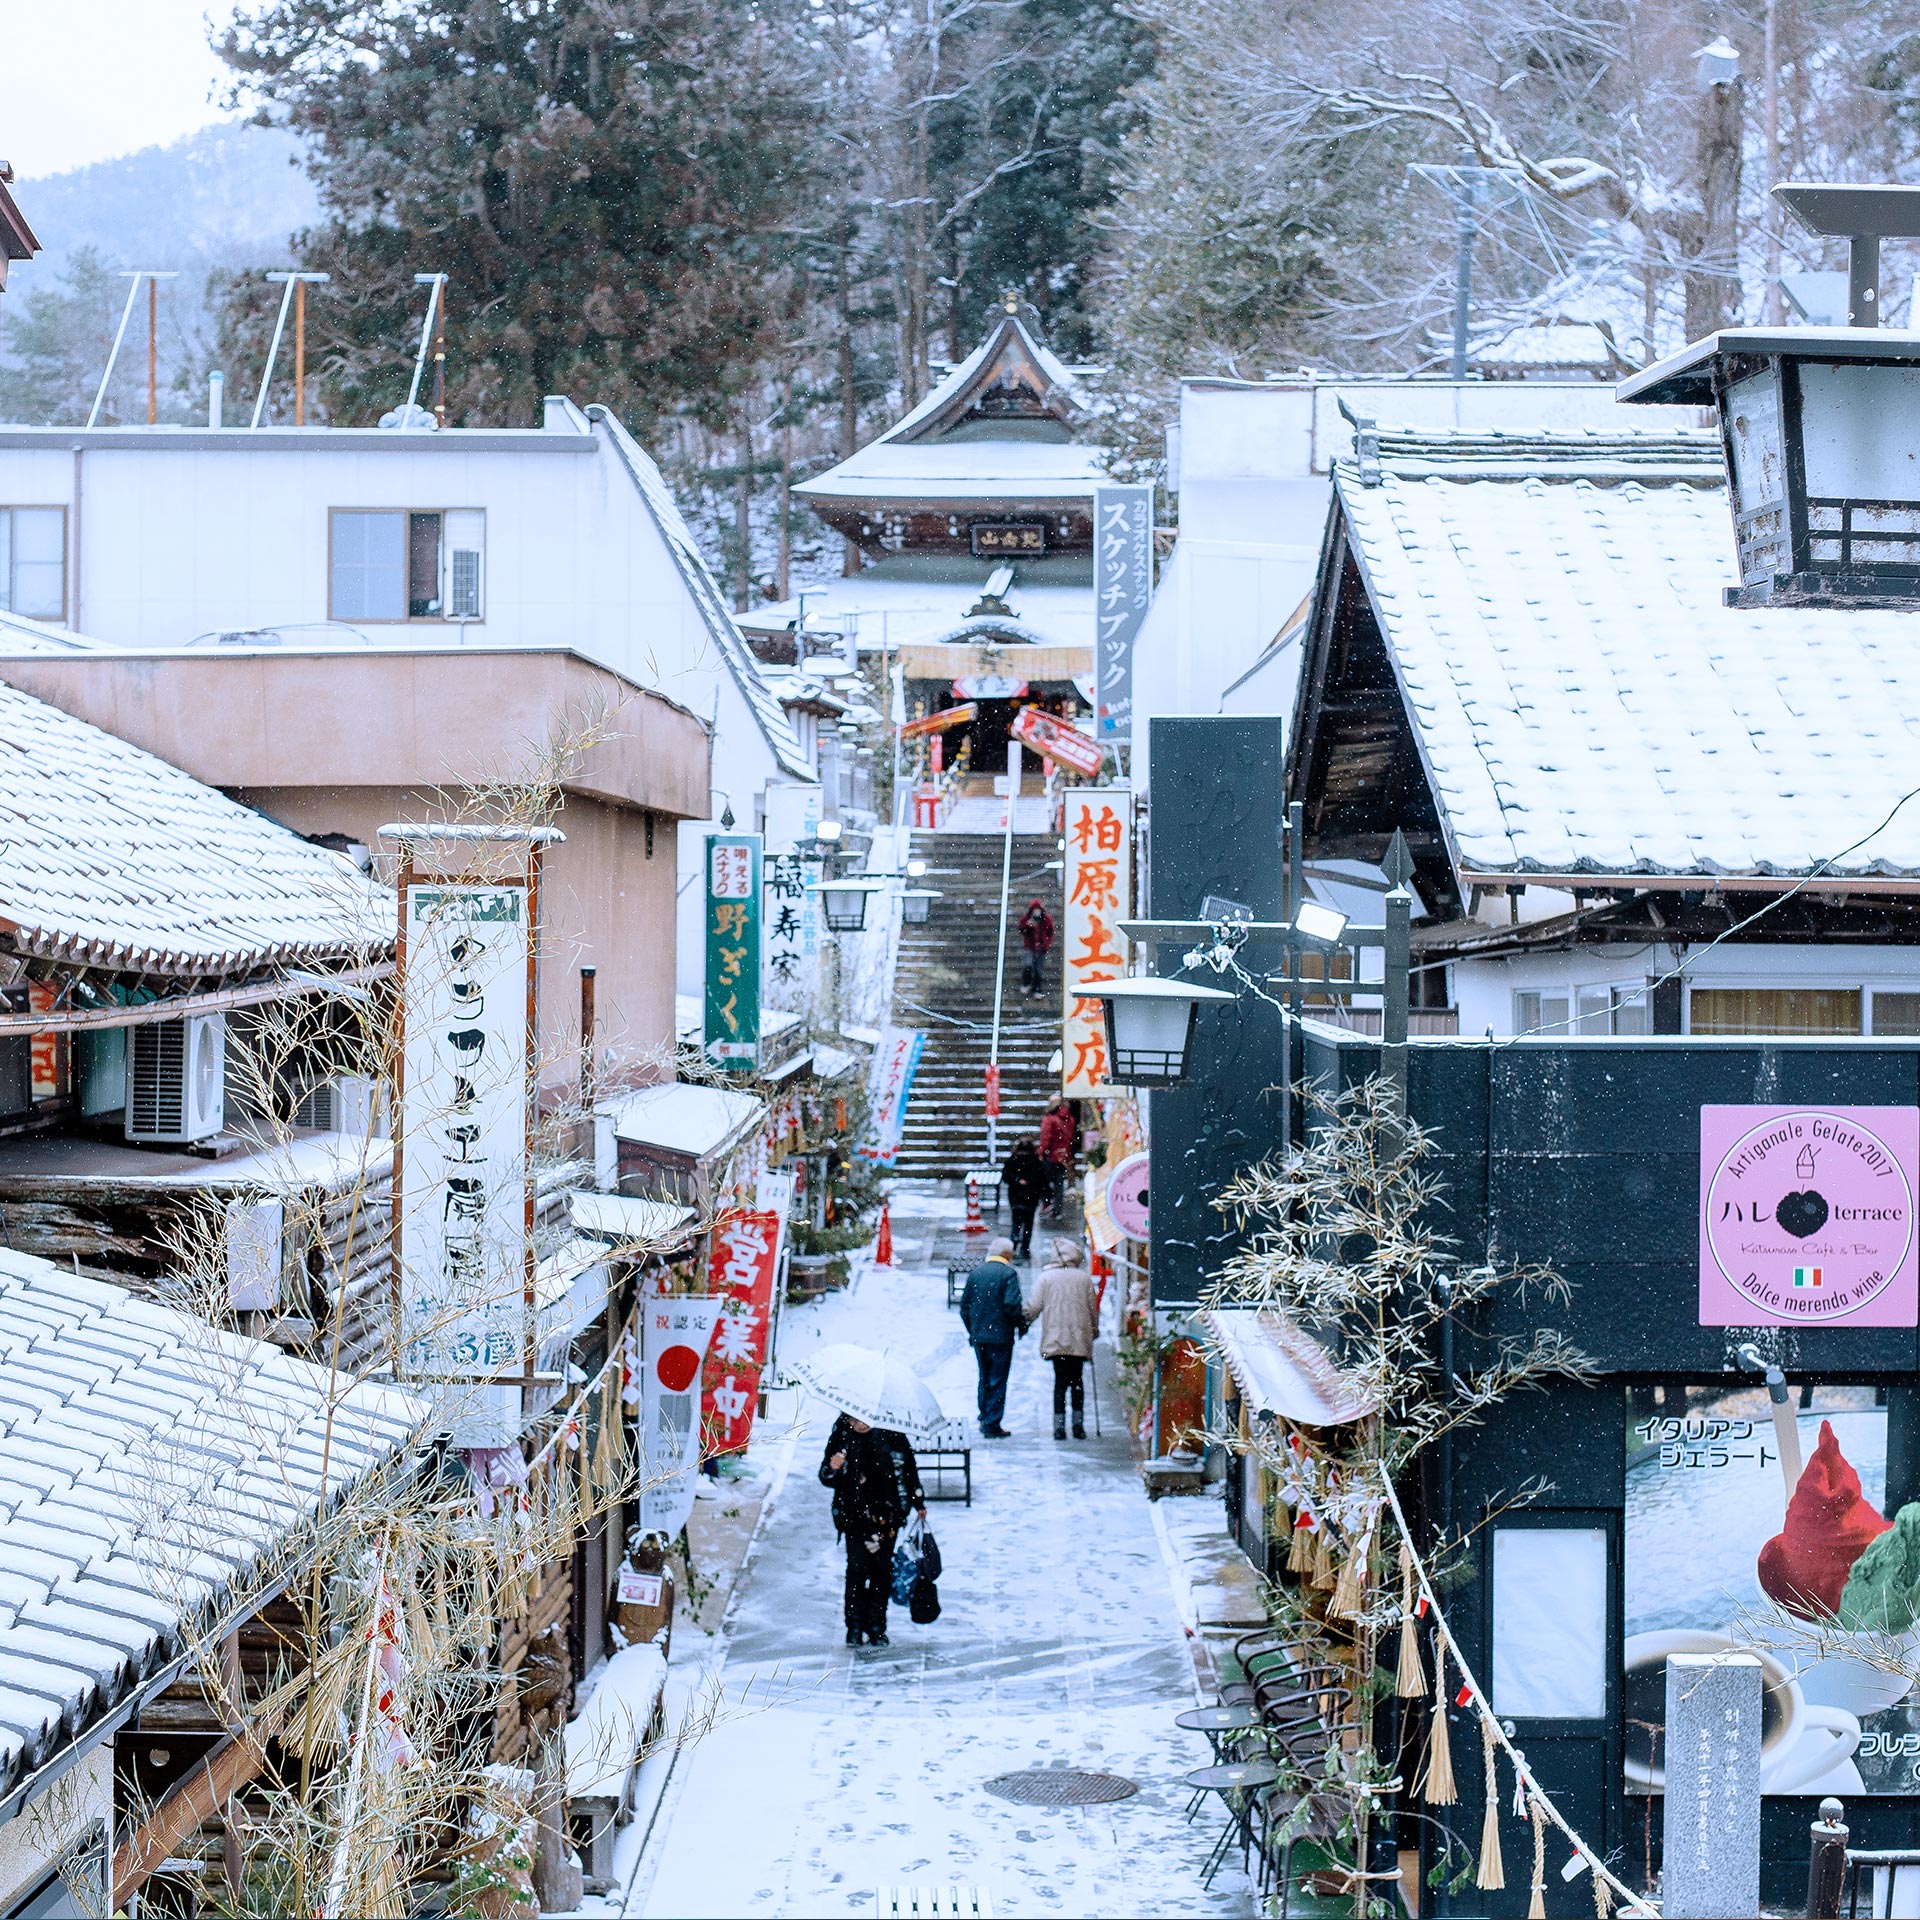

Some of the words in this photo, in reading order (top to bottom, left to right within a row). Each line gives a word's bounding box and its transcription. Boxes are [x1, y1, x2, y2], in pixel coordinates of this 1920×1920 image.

[715, 848, 730, 894] スナック
[712, 903, 749, 1034] 野ぎく
[1728, 1121, 1803, 1180] Artiganale
[1834, 1200, 1902, 1221] terrace
[1849, 1243, 1878, 1255] Bar
[1742, 1272, 1780, 1306] Dolce
[1784, 1291, 1849, 1313] merenda
[1852, 1270, 1884, 1299] wine
[656, 1314, 707, 1330] 祝認定
[712, 1221, 768, 1441] 営業中
[1635, 1417, 1754, 1443] イタリアン
[1660, 1443, 1777, 1469] ジェラート
